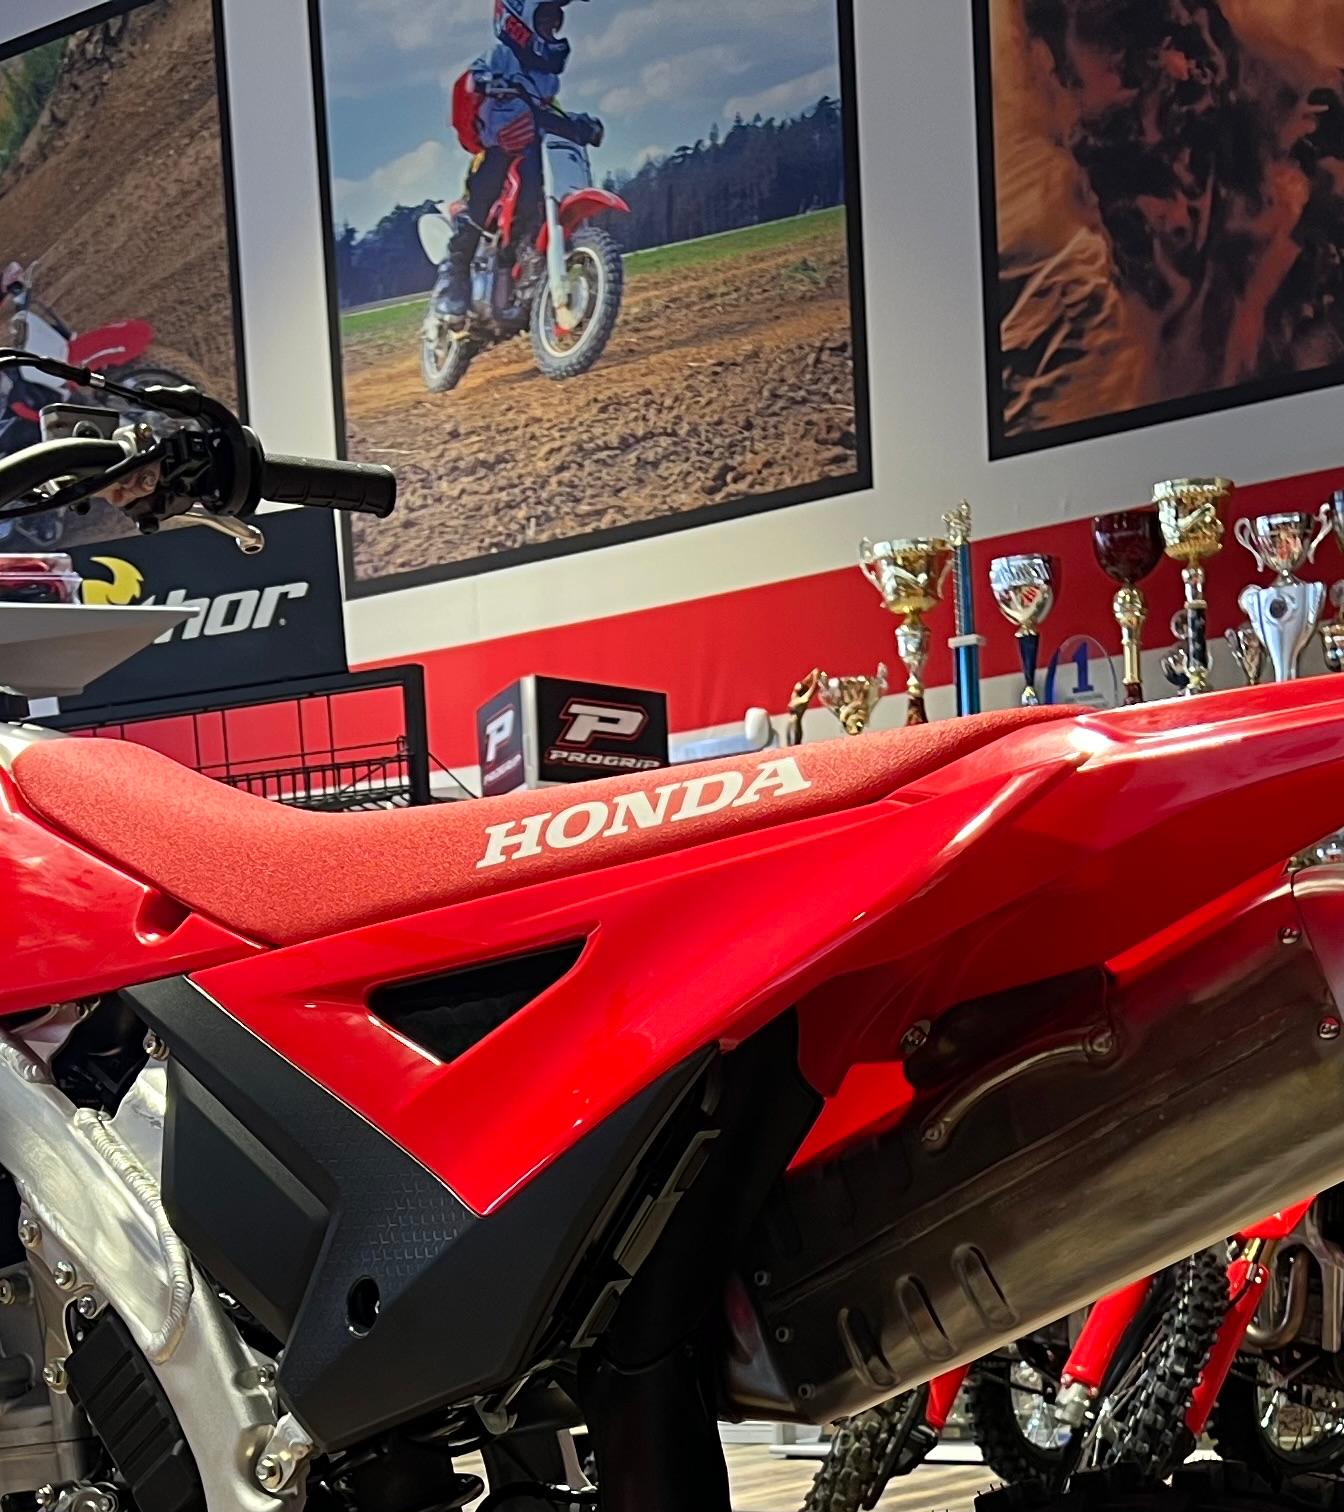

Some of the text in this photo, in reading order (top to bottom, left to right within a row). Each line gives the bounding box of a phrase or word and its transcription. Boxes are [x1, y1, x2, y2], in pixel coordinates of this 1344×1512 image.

[144, 582, 309, 645] hor
[548, 750, 660, 769] PROGRIP
[476, 756, 812, 869] HONDA
